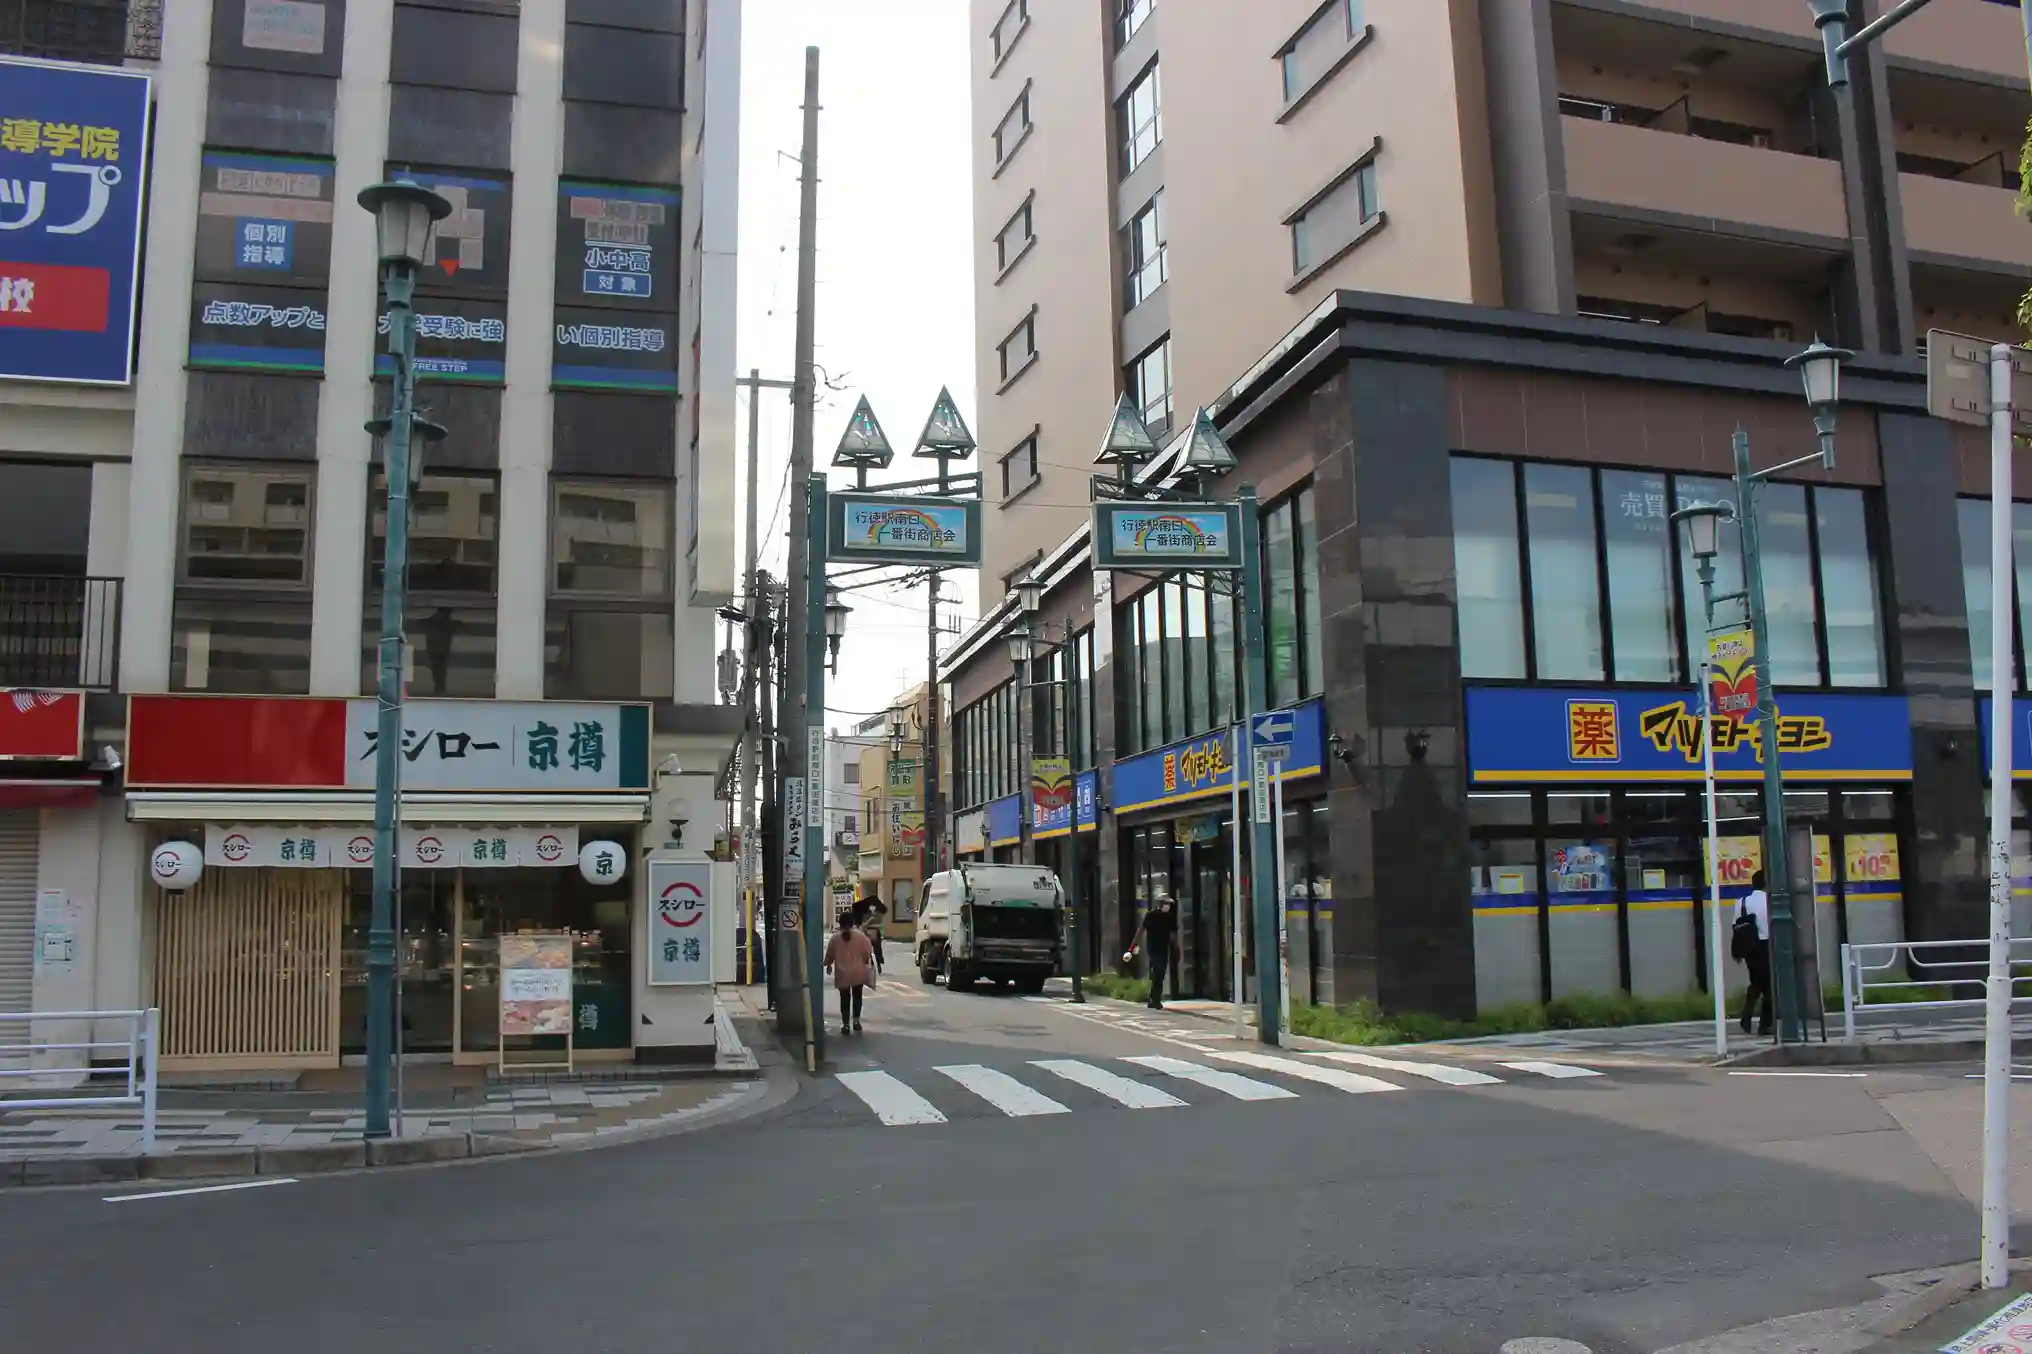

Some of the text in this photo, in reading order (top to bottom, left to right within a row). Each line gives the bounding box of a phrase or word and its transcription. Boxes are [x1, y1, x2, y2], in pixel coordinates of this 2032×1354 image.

[244, 223, 287, 243] 個別
[243, 245, 285, 265] 指導
[597, 274, 637, 292] 対象
[202, 300, 326, 329] 点数アップと
[556, 324, 665, 352] い個別指導
[412, 362, 439, 372] FREE
[855, 510, 920, 525] 行徳駅南口
[880, 526, 956, 543] 一番街商店会
[1145, 533, 1217, 547] 一番街商店会
[1573, 708, 1615, 757] 薬
[527, 720, 606, 773] 京樽
[1164, 755, 1177, 791] 薬
[280, 838, 317, 861] 京樽
[472, 838, 507, 861] 京樽
[595, 851, 613, 876] 京
[659, 898, 706, 911] スシロー
[662, 937, 702, 963] 京樽
